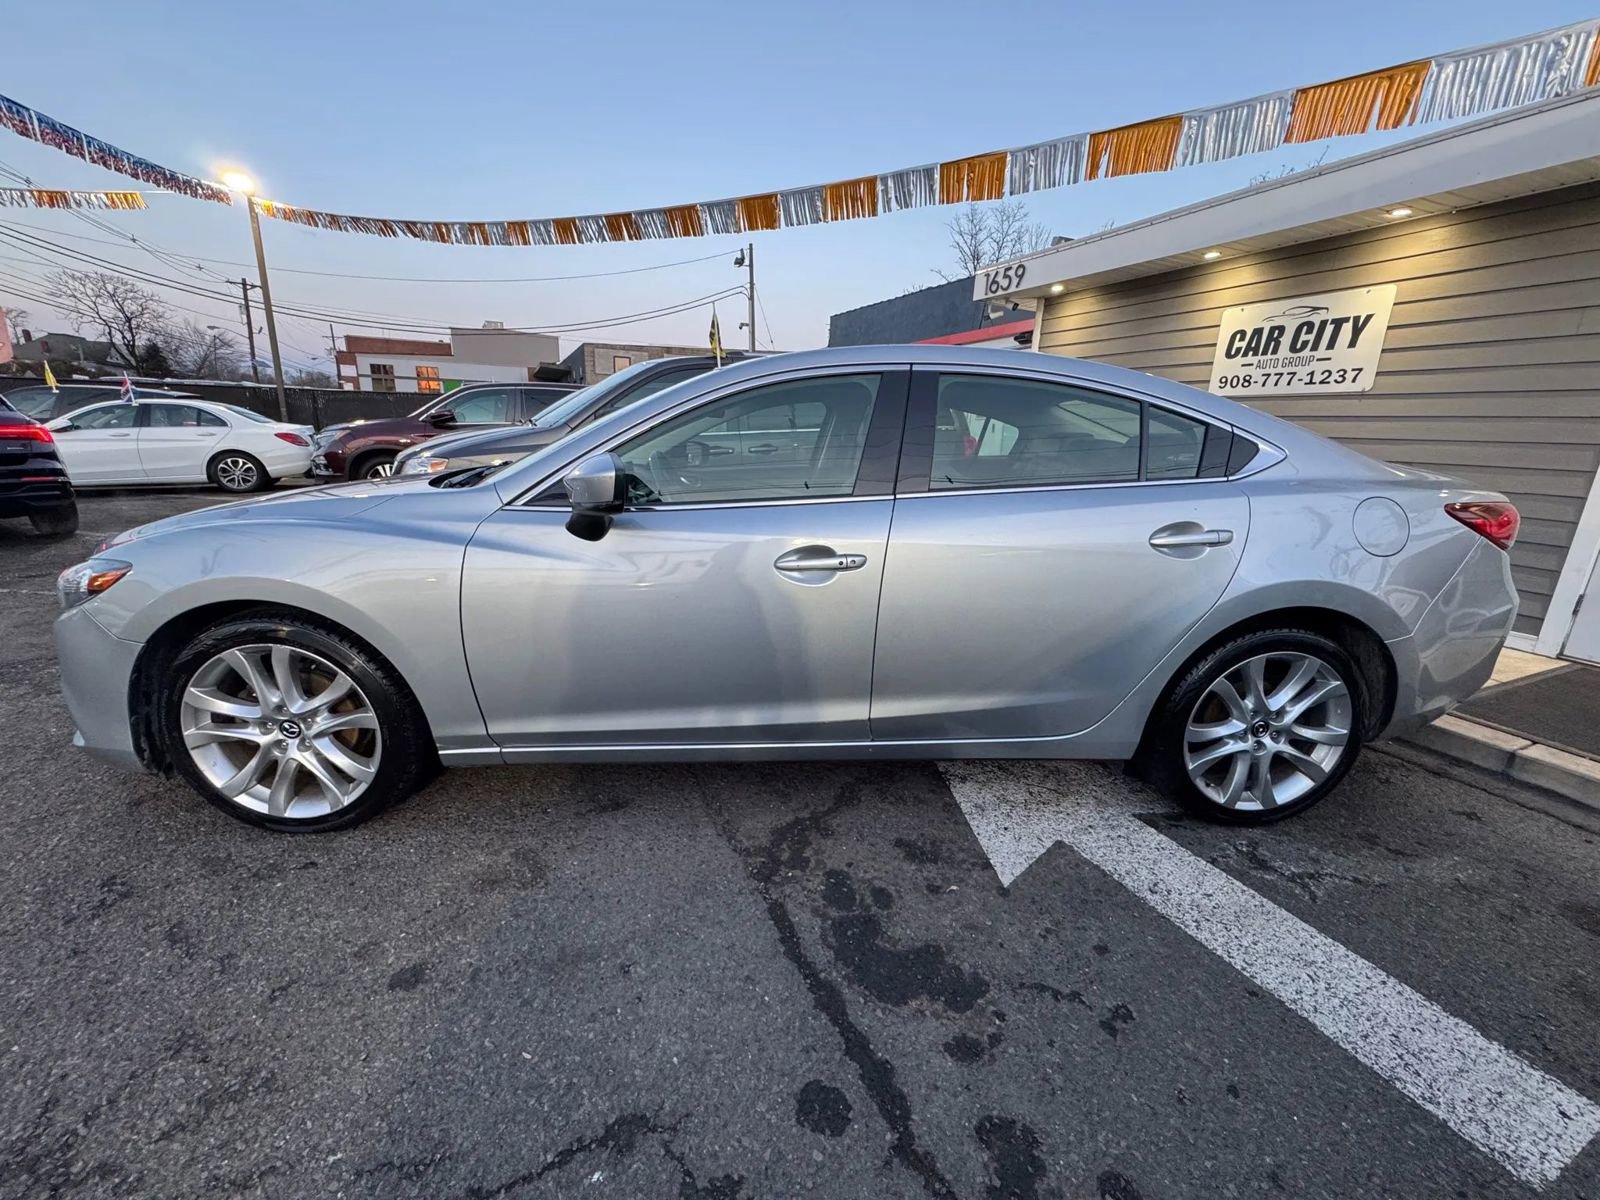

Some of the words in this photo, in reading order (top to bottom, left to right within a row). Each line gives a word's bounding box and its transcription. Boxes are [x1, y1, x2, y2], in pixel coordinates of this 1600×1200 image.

[984, 264, 1026, 296] 1659
[1224, 325, 1286, 359] CAR
[1288, 313, 1376, 354] CITY
[1255, 358, 1279, 370] AUTO
[1281, 355, 1315, 369] GROUP
[1218, 367, 1364, 389] 908-777-1237
